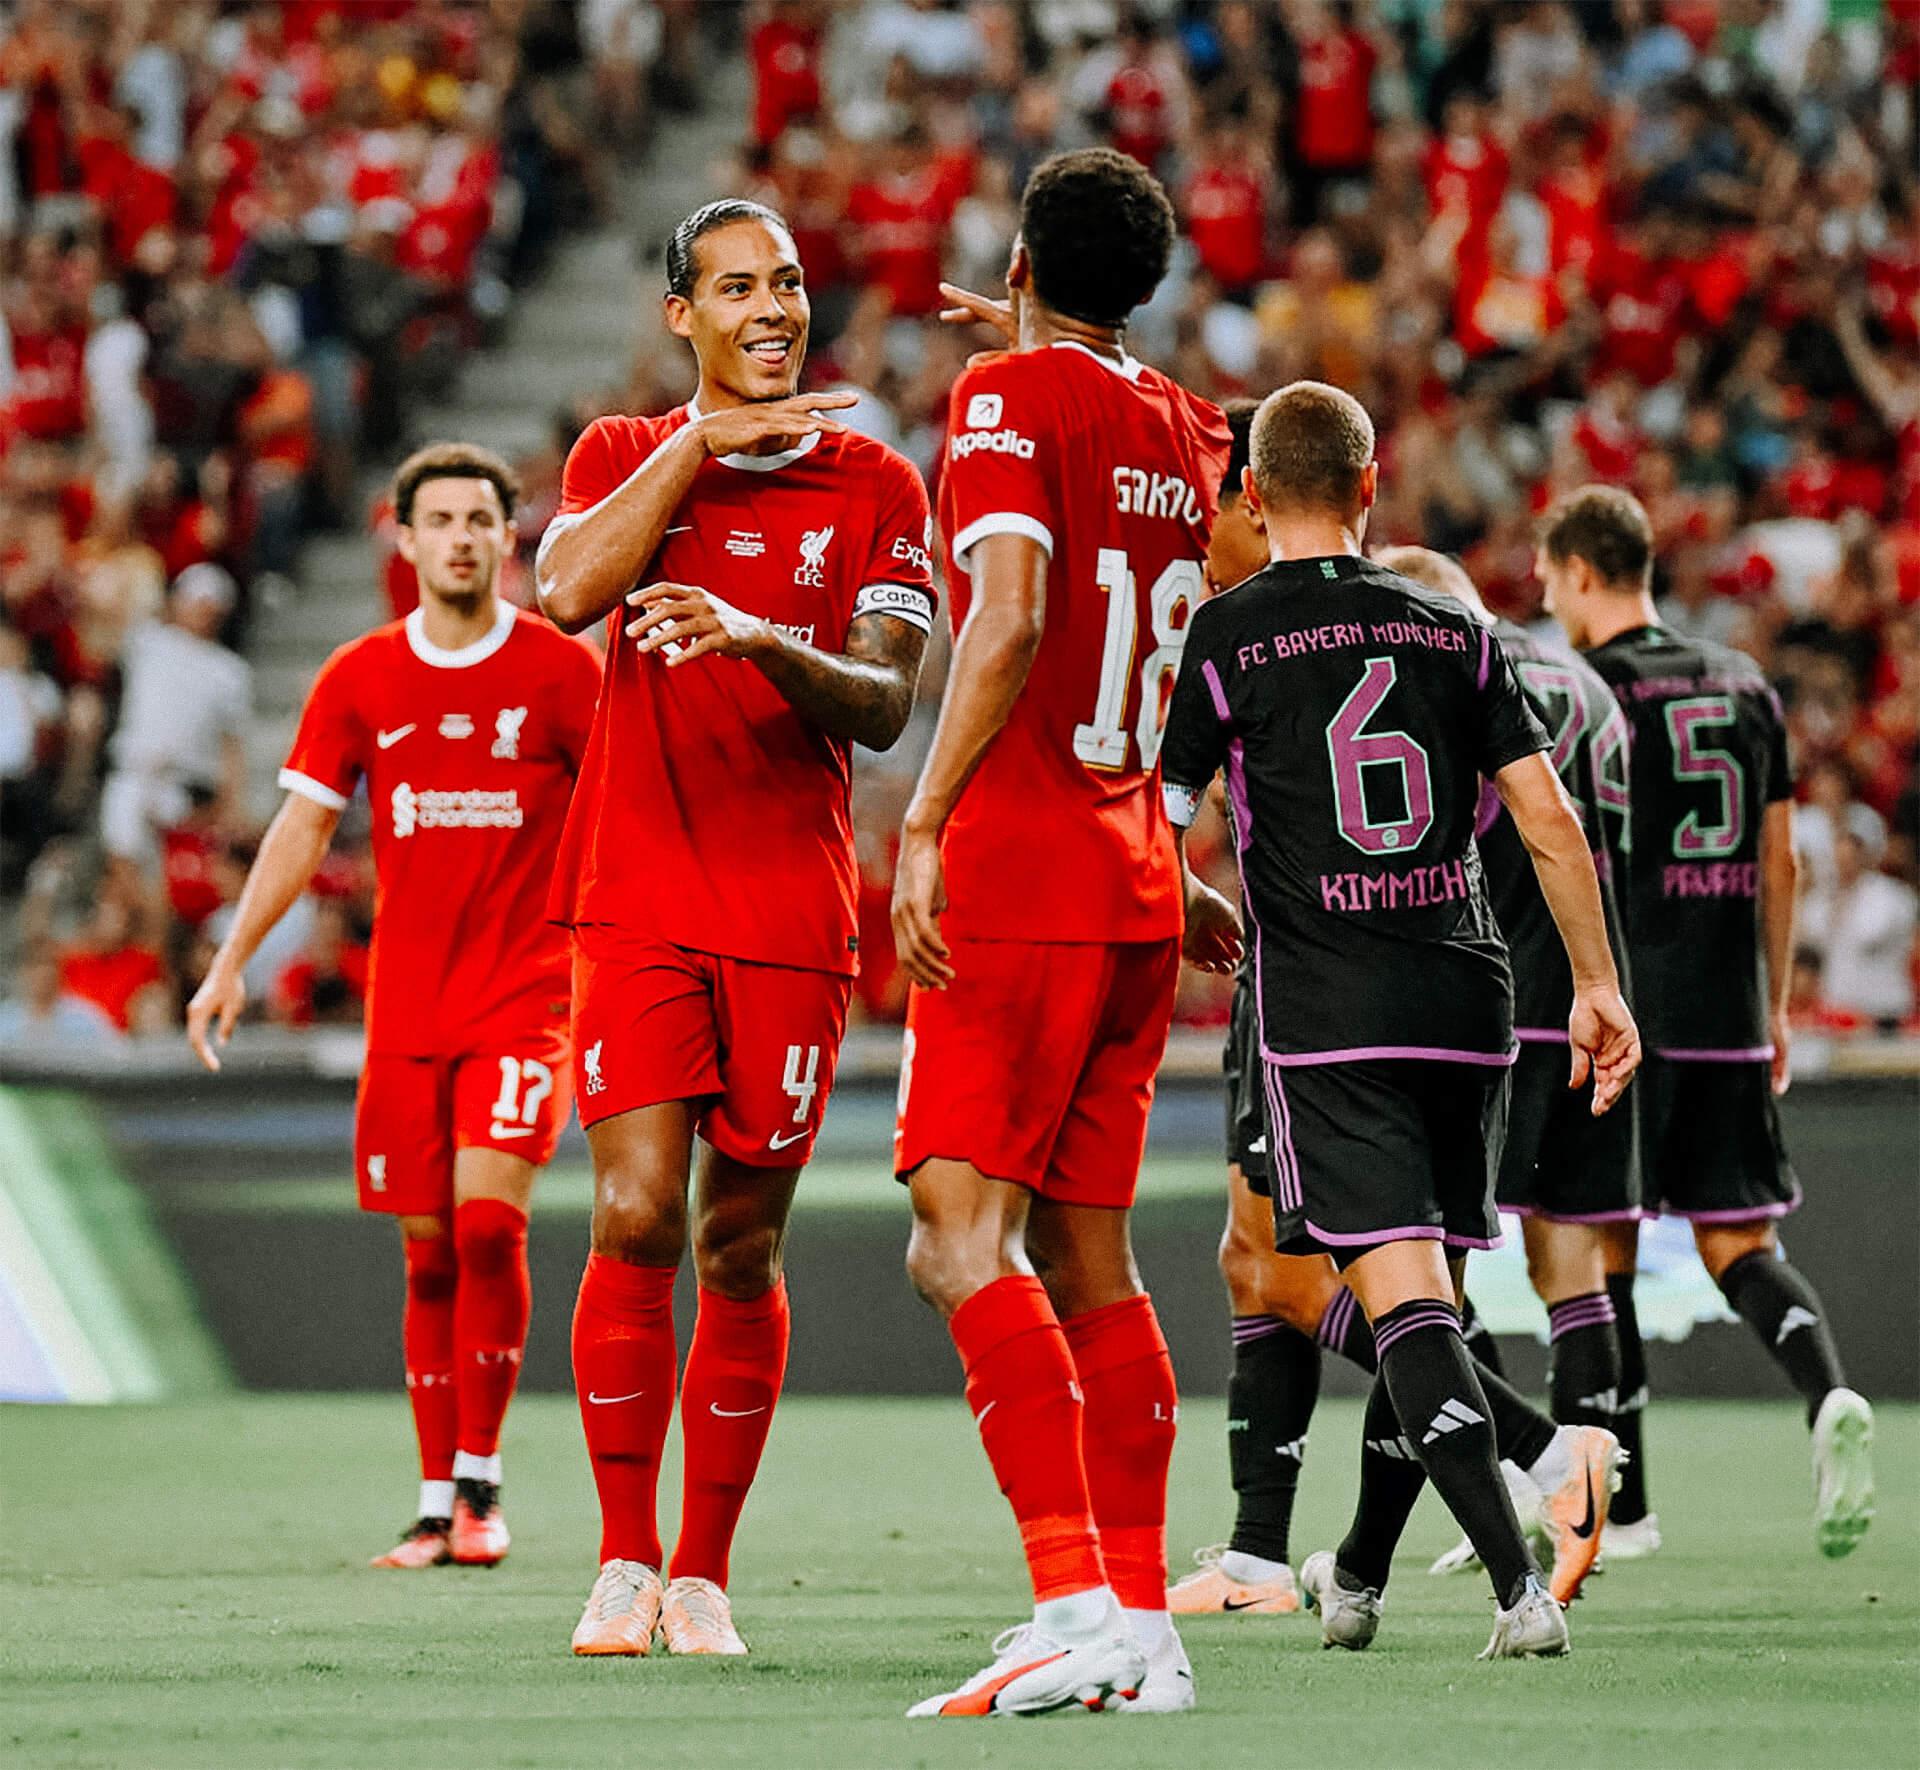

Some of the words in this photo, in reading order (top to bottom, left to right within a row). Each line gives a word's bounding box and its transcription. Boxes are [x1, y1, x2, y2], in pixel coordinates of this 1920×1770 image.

[793, 569, 824, 588] LFC
[891, 537, 931, 572] Exp
[1073, 547, 1203, 774] 18
[1237, 642, 1267, 671] FC
[1273, 622, 1365, 660] BAYERN
[1326, 655, 1435, 856] 6
[1663, 696, 1745, 859] 5
[416, 789, 518, 809] standard
[1320, 859, 1467, 912] KIMMICH
[491, 1056, 553, 1126] 17
[781, 1045, 820, 1124] 4
